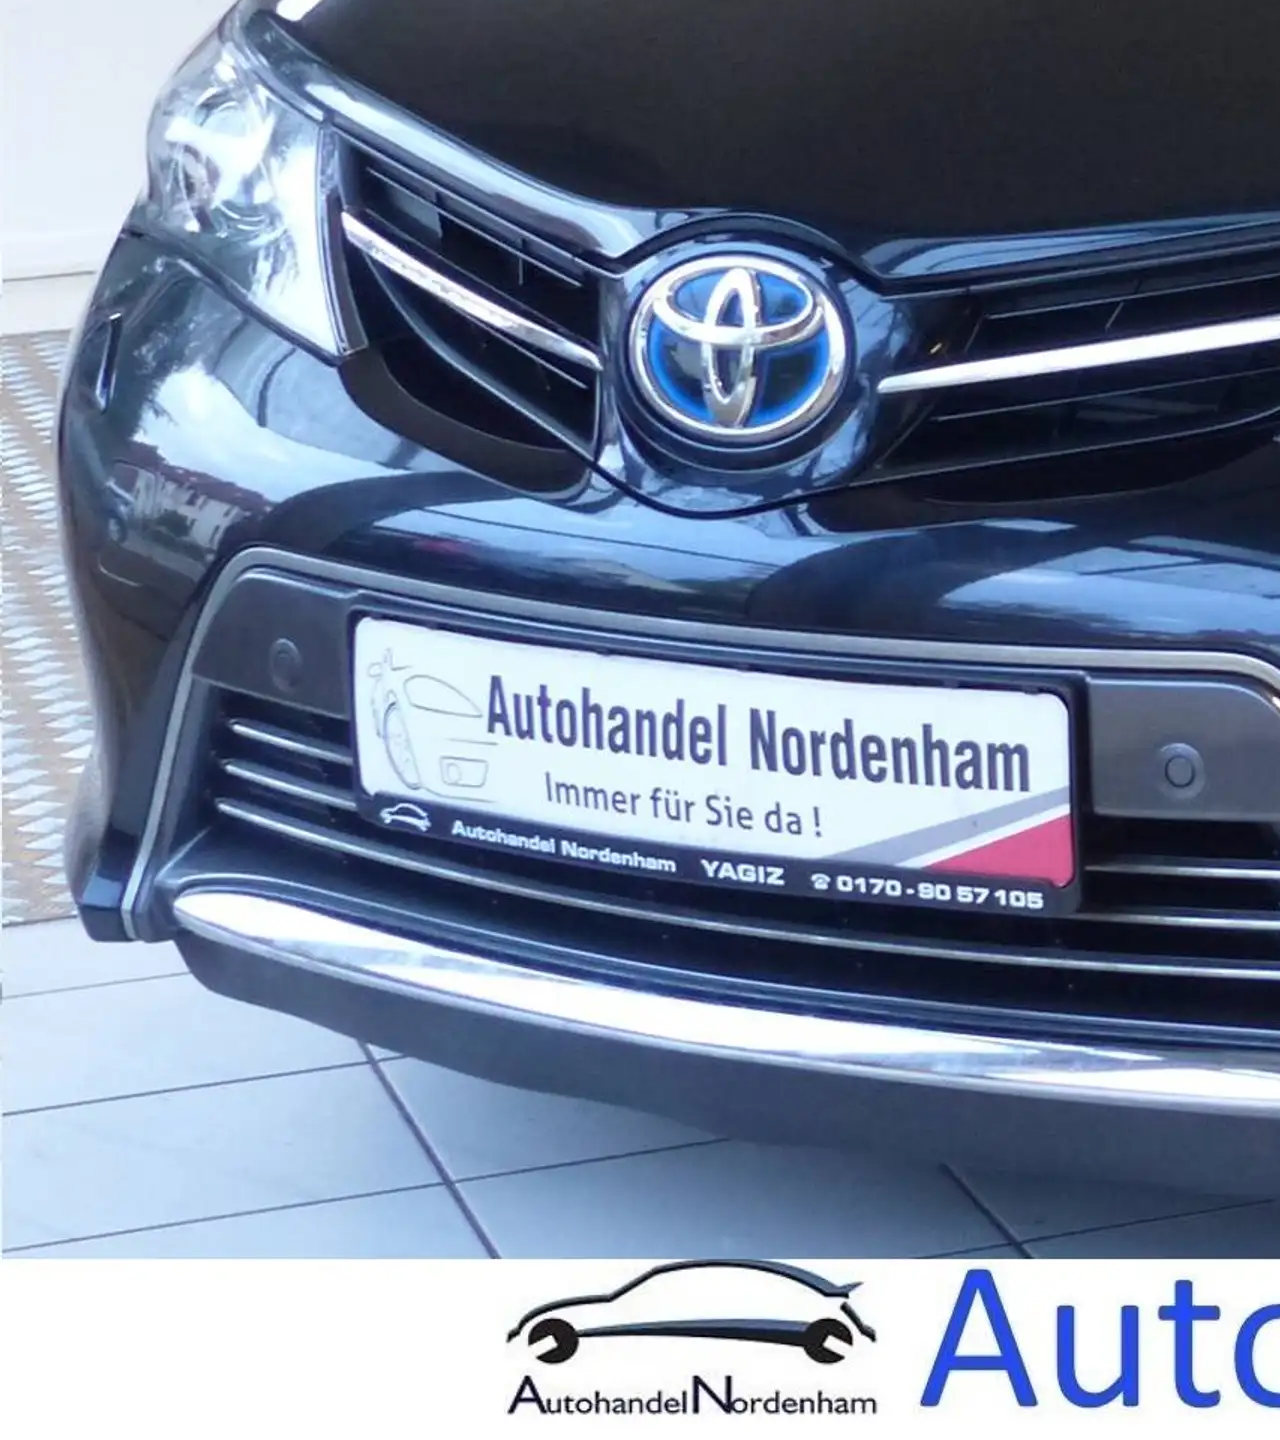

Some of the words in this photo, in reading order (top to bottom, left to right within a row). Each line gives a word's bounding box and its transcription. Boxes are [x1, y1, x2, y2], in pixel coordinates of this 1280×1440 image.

[484, 674, 728, 767] Autohandel
[748, 708, 1032, 793] Nordenham
[545, 770, 642, 816] Immer
[649, 786, 697, 824] für
[704, 794, 754, 831] Sie
[764, 801, 803, 835] da
[451, 819, 556, 854] Autohandel
[560, 839, 678, 874] Nordenham
[701, 859, 785, 887] YAGIZ
